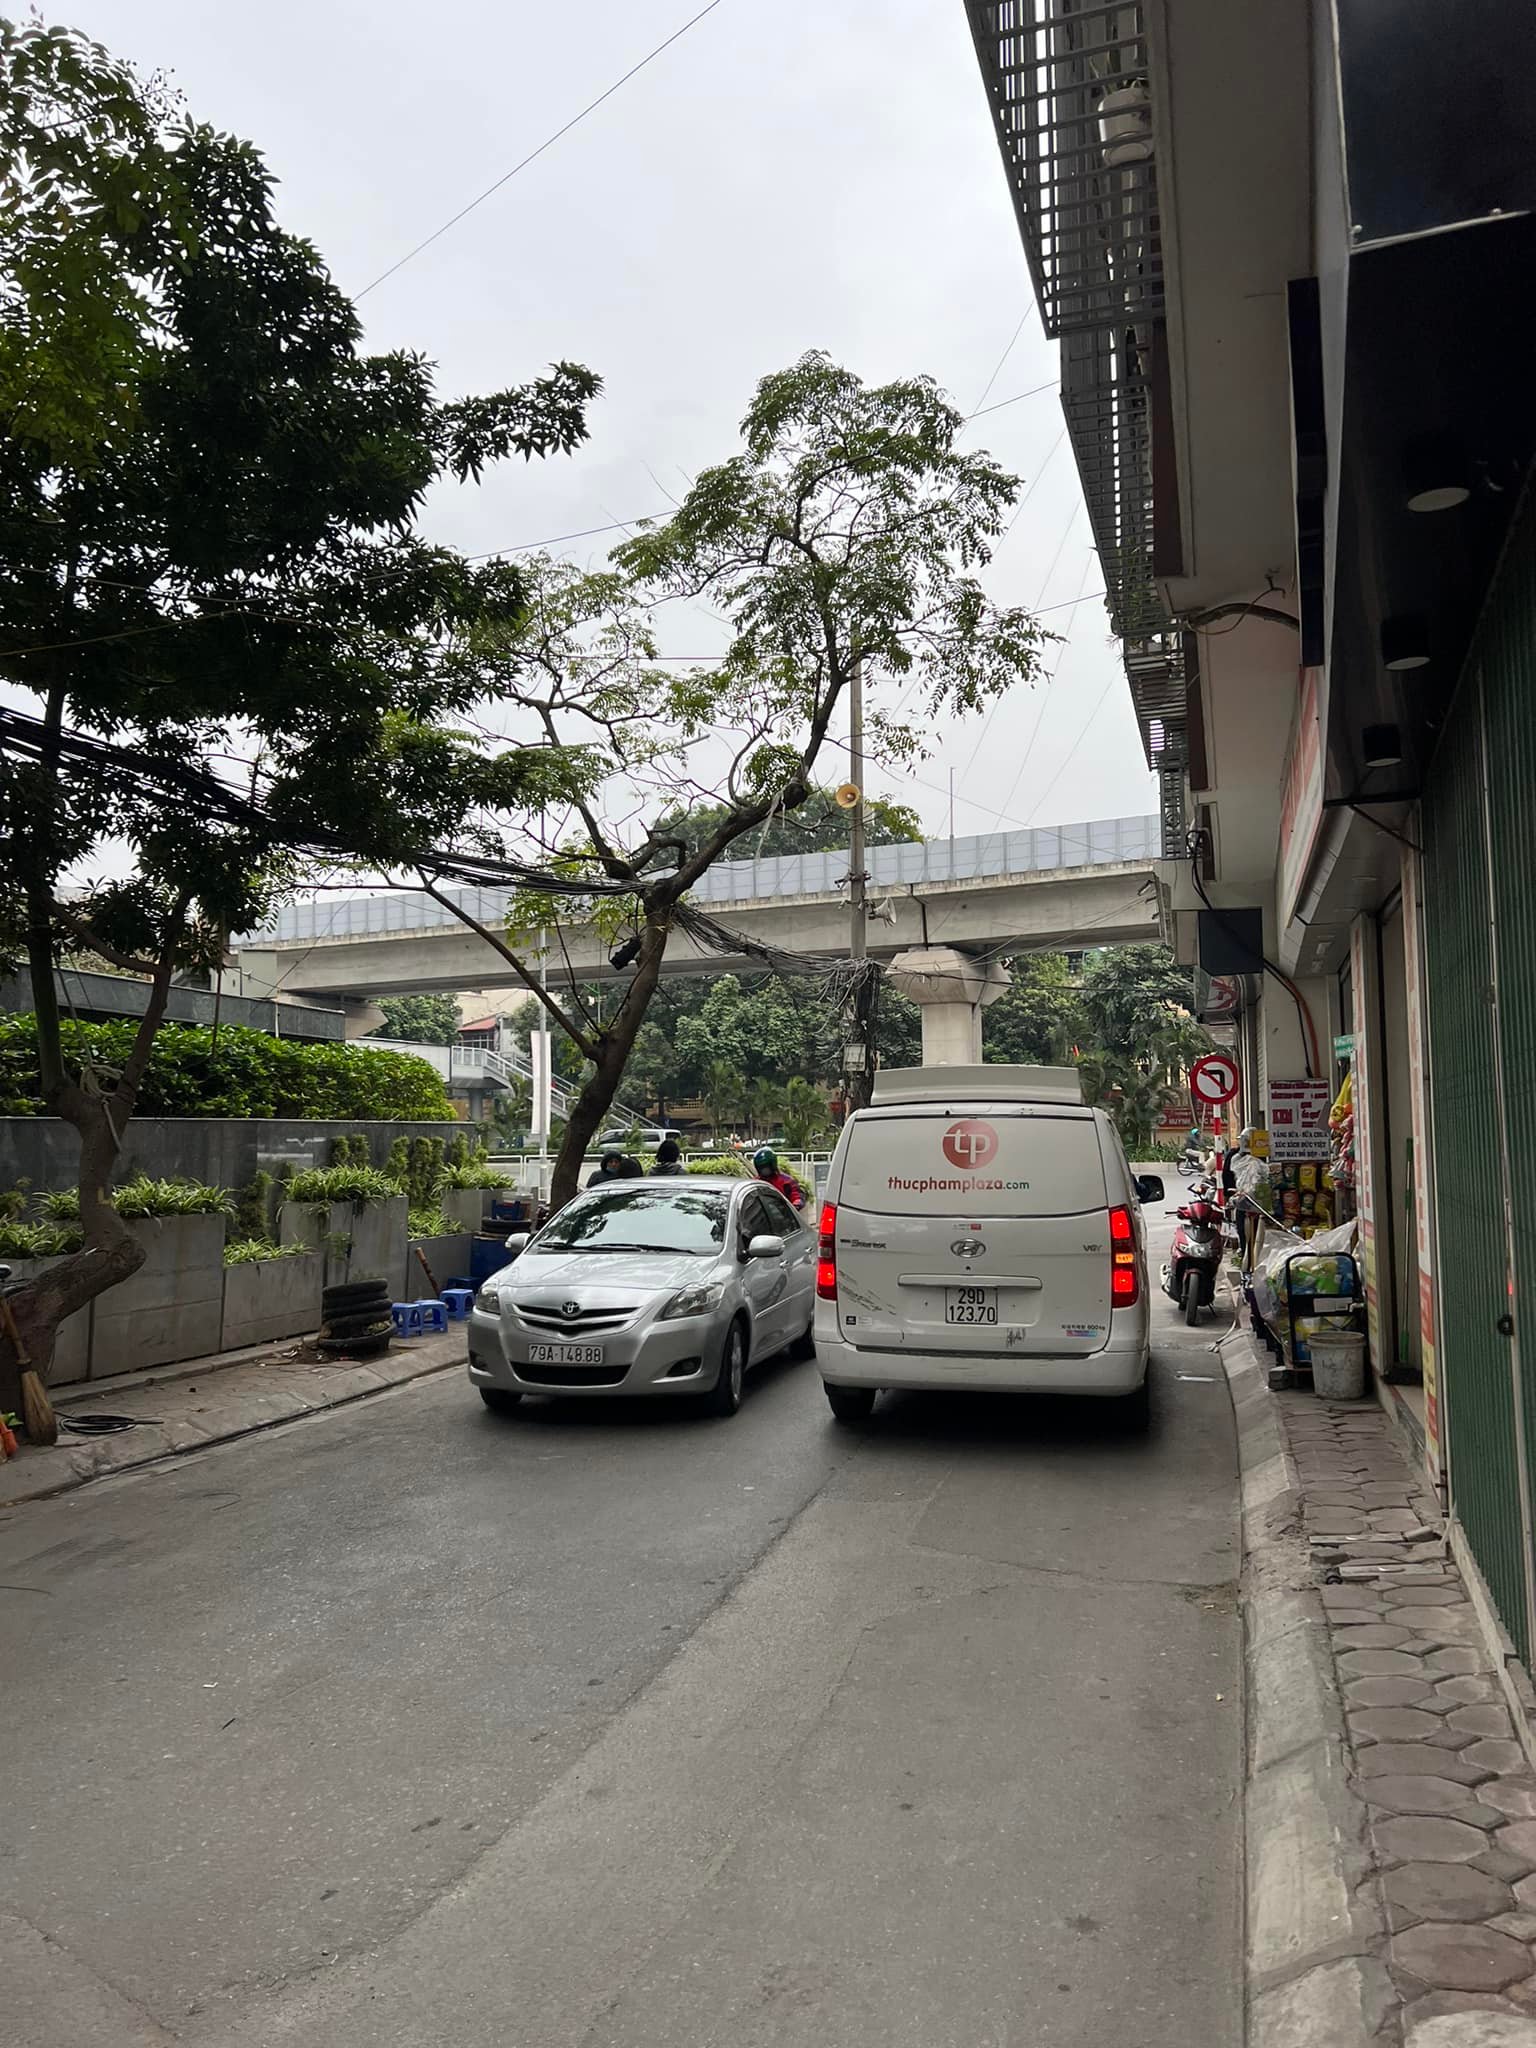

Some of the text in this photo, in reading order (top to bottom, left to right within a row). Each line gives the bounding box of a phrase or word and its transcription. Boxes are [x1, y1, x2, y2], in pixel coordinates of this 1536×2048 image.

[888, 1177, 1030, 1193] thucphamplaza.com
[958, 1288, 985, 1305] 29D
[949, 1305, 996, 1322] 123.70
[530, 1345, 601, 1363] 79A-148.88
